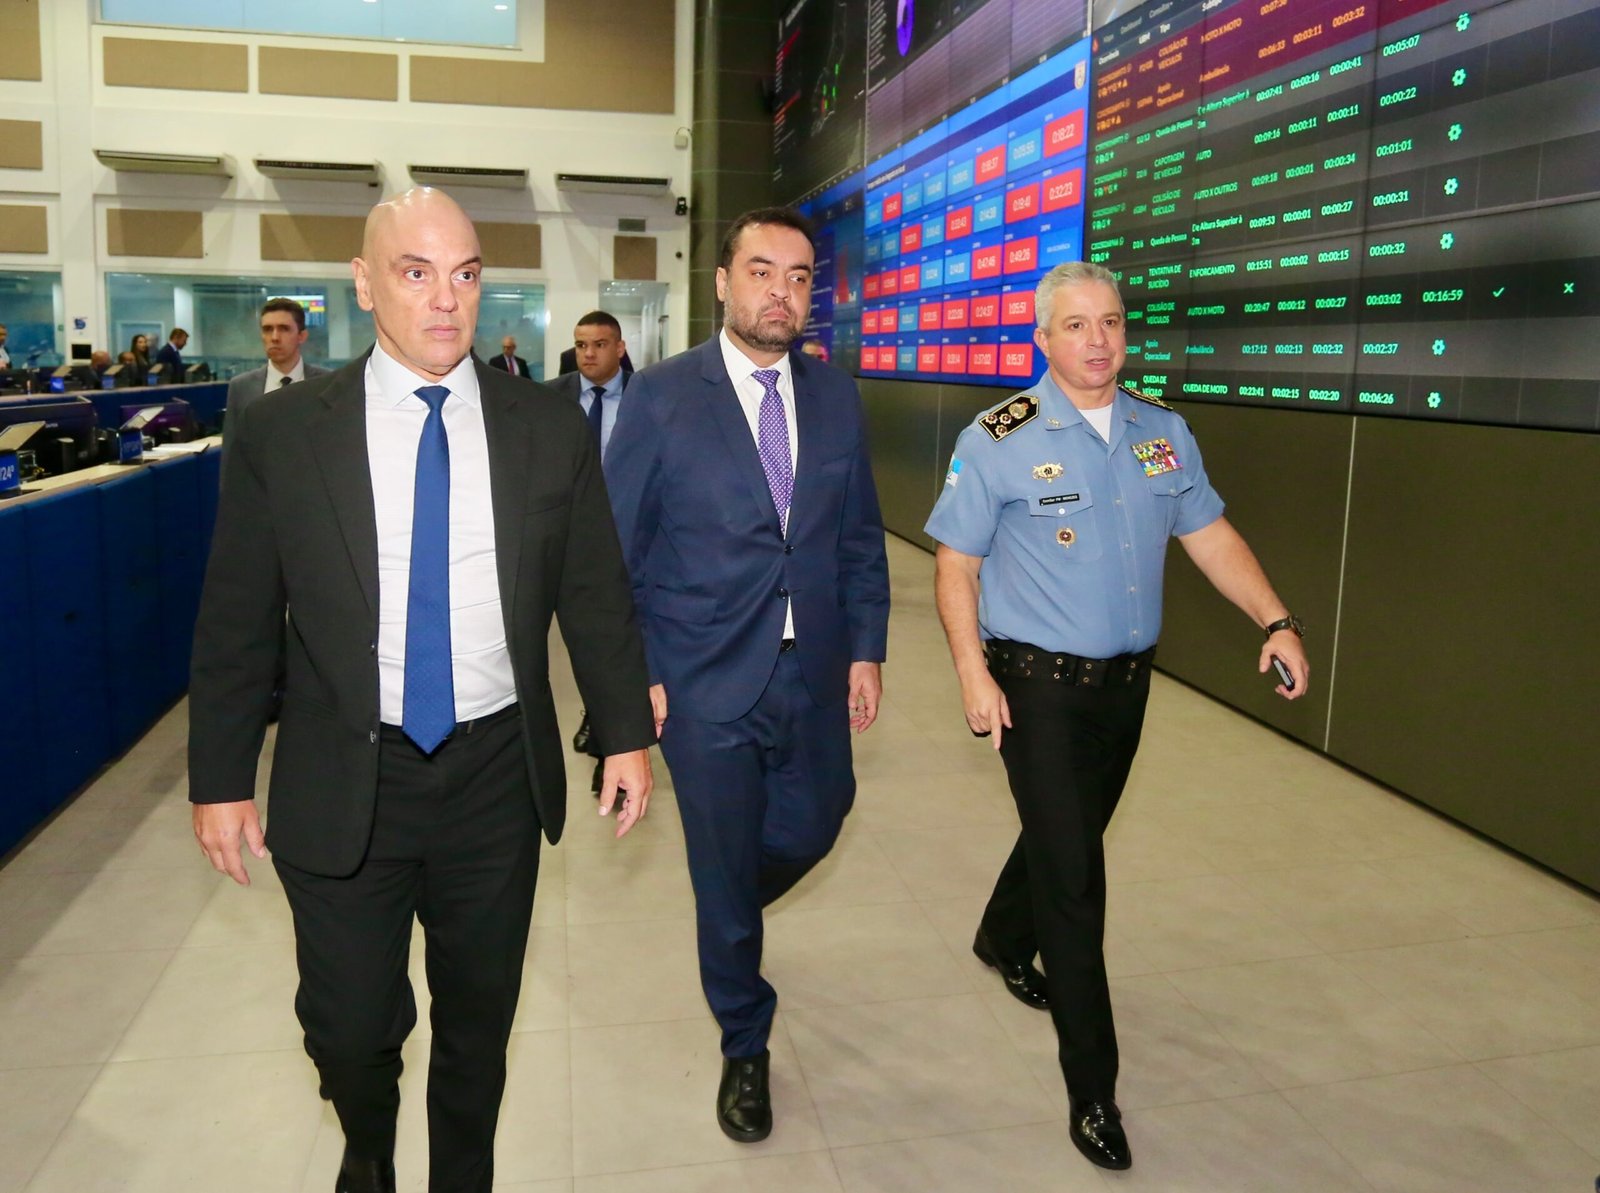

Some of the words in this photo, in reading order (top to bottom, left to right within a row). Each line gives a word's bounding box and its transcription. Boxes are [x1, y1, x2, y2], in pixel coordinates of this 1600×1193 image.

[1333, 6, 1364, 27] 00:03:32
[1293, 25, 1321, 43] 00:03:11
[1383, 34, 1421, 56] 00:05:07
[1329, 56, 1363, 75] 00:00:41
[1289, 72, 1321, 90] 00:00:16
[1256, 87, 1284, 102] 00:07:41
[1380, 87, 1416, 106] 00:00:22
[1327, 104, 1359, 122] 00:00:11
[1288, 117, 1317, 134] 00:00:11
[1254, 128, 1280, 144] 00:09:16
[1376, 139, 1412, 157] 00:01:01
[1196, 149, 1212, 161] AUTO
[1324, 153, 1356, 170] 00:00:34
[1285, 164, 1314, 179] 00:00:01
[1193, 190, 1210, 201] AUTO
[1209, 188, 1214, 197] X
[1213, 181, 1238, 196] OUTROS
[1373, 190, 1409, 206] 00:00:31
[1321, 201, 1353, 216] 00:00:27
[1283, 209, 1311, 222] 00:00:01
[1200, 221, 1216, 232] Altura
[1216, 216, 1238, 229] Superior
[1249, 217, 1275, 230] 00:09:53
[1369, 242, 1407, 256] 00:00:32
[1280, 254, 1310, 267] 00:00:02
[1318, 249, 1351, 263] 00:00:15
[1173, 264, 1182, 273] DE
[1189, 263, 1236, 279] ENFORCAMENTO
[1246, 259, 1272, 271] 00:15:51
[1366, 293, 1401, 305] 00:03:02
[1423, 289, 1463, 302] 00:16:59
[1244, 302, 1270, 312] 00:20:47
[1278, 300, 1306, 311] 00:00:12
[1315, 297, 1346, 308] 00:00:27
[1187, 307, 1203, 316] AUTO
[1207, 305, 1226, 315] MOTO
[1242, 344, 1267, 354] 00:17:12
[1275, 344, 1303, 354] 00:02:13
[1312, 344, 1344, 355] 00:02:32
[1363, 343, 1398, 354] 00:02:37
[1142, 375, 1160, 385] QUEDA
[1160, 376, 1167, 384] DE
[1182, 383, 1201, 394] QUEDA
[1201, 384, 1210, 394] DE
[1210, 384, 1229, 395] MOTO
[1239, 386, 1264, 396] 00:23:41
[1272, 388, 1299, 398] 00:02:15
[1309, 390, 1340, 401] 00:02:20
[1359, 392, 1394, 404] 00:06:26
